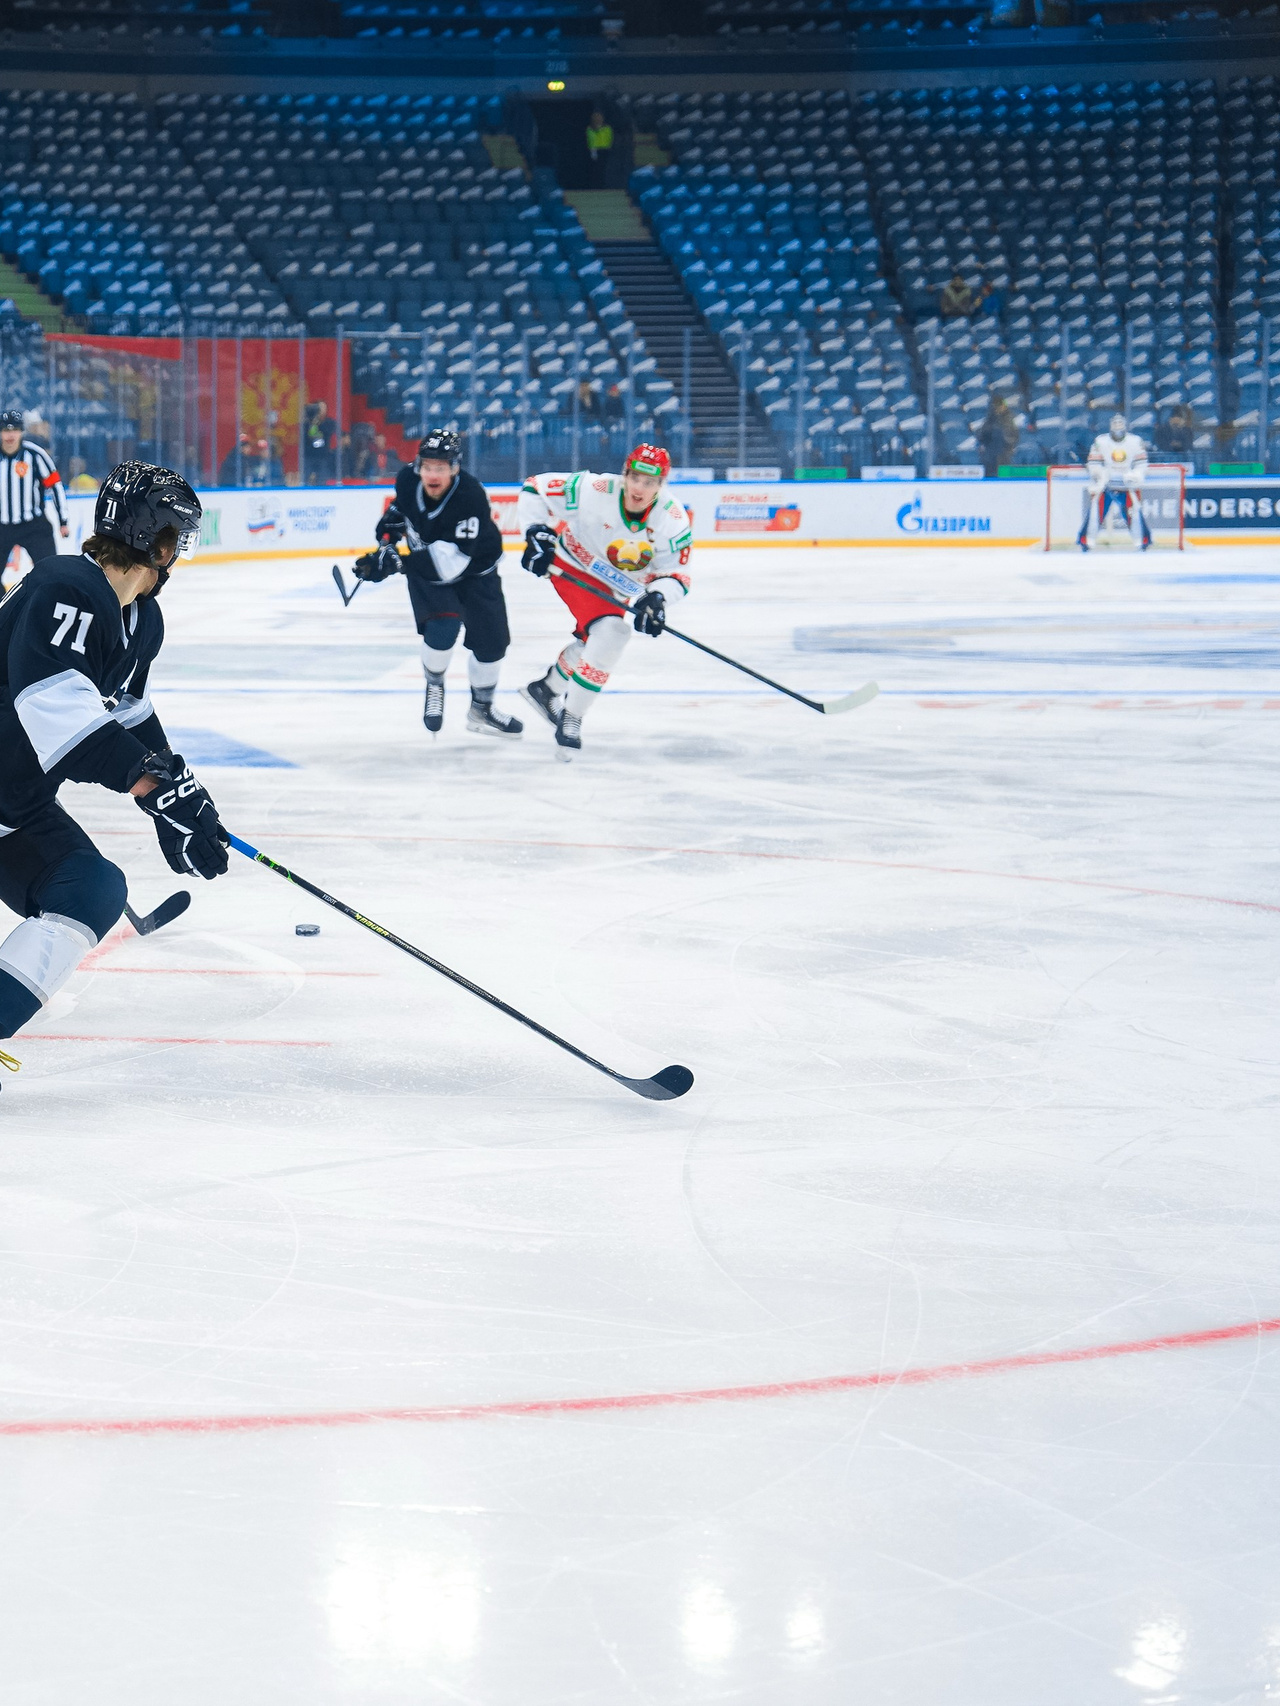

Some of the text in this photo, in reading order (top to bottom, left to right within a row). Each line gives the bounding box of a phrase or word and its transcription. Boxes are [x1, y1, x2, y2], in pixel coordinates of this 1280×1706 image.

[105, 498, 118, 520] 71
[173, 504, 193, 515] BAUER
[455, 516, 480, 539] 29
[50, 601, 94, 655] 71
